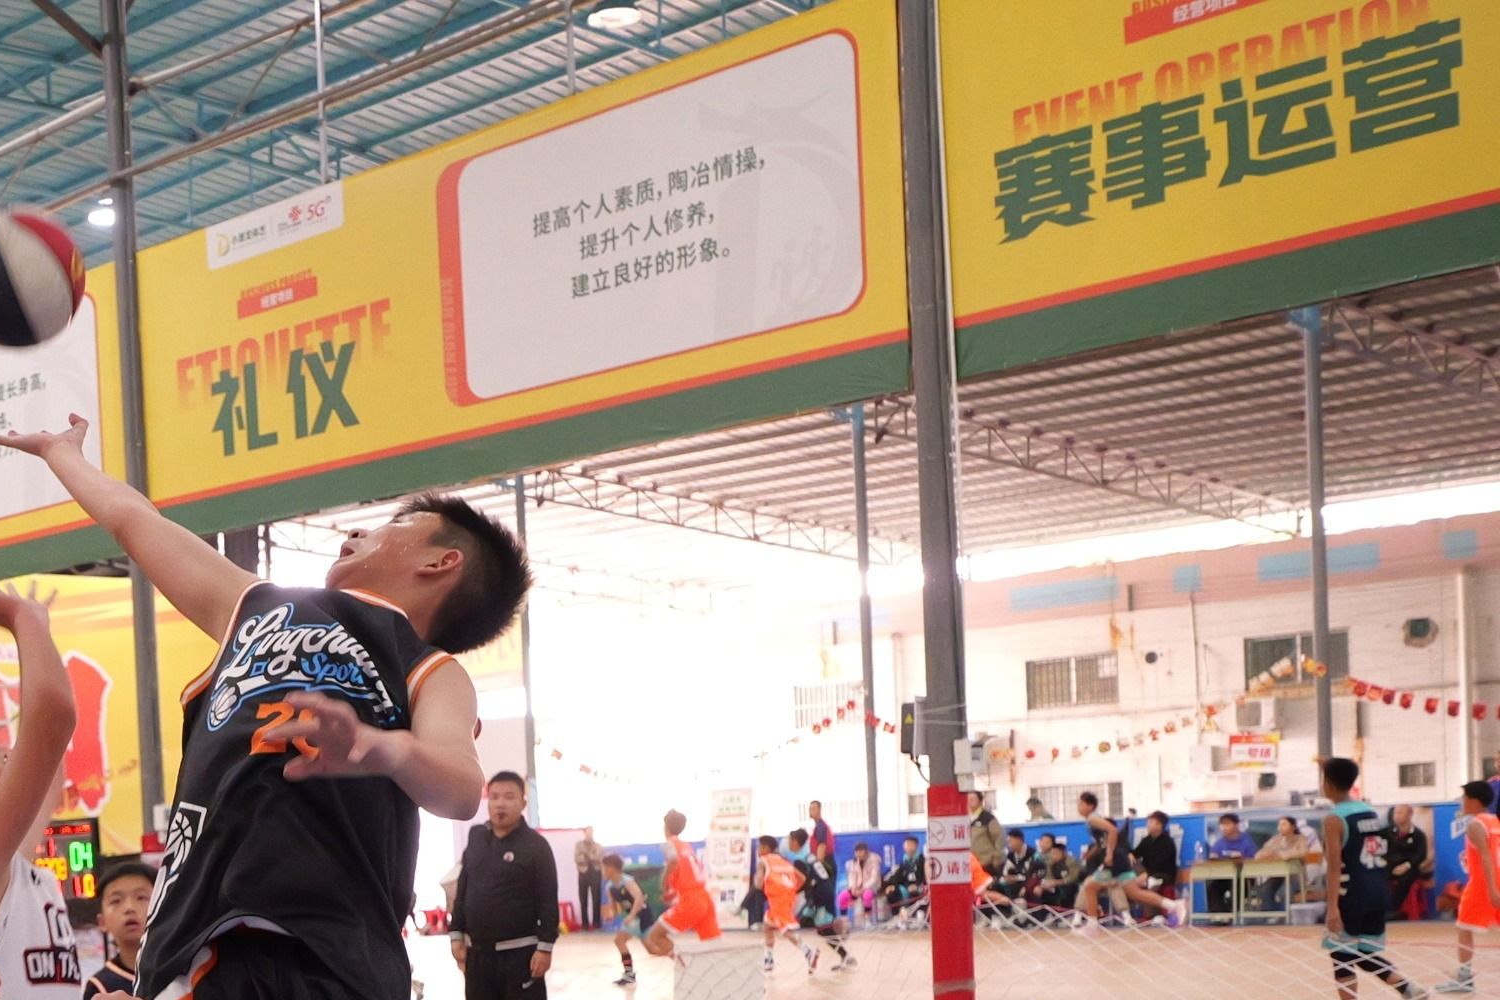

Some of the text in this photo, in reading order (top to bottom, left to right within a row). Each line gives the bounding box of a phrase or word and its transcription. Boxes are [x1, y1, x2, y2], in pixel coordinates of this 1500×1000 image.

[1013, 0, 1430, 141] EVENT OPERATION
[994, 18, 1463, 245] 赛事运营
[177, 298, 391, 408] ETIQUETTE
[211, 340, 360, 456] 礼仪
[69, 841, 94, 872] 04
